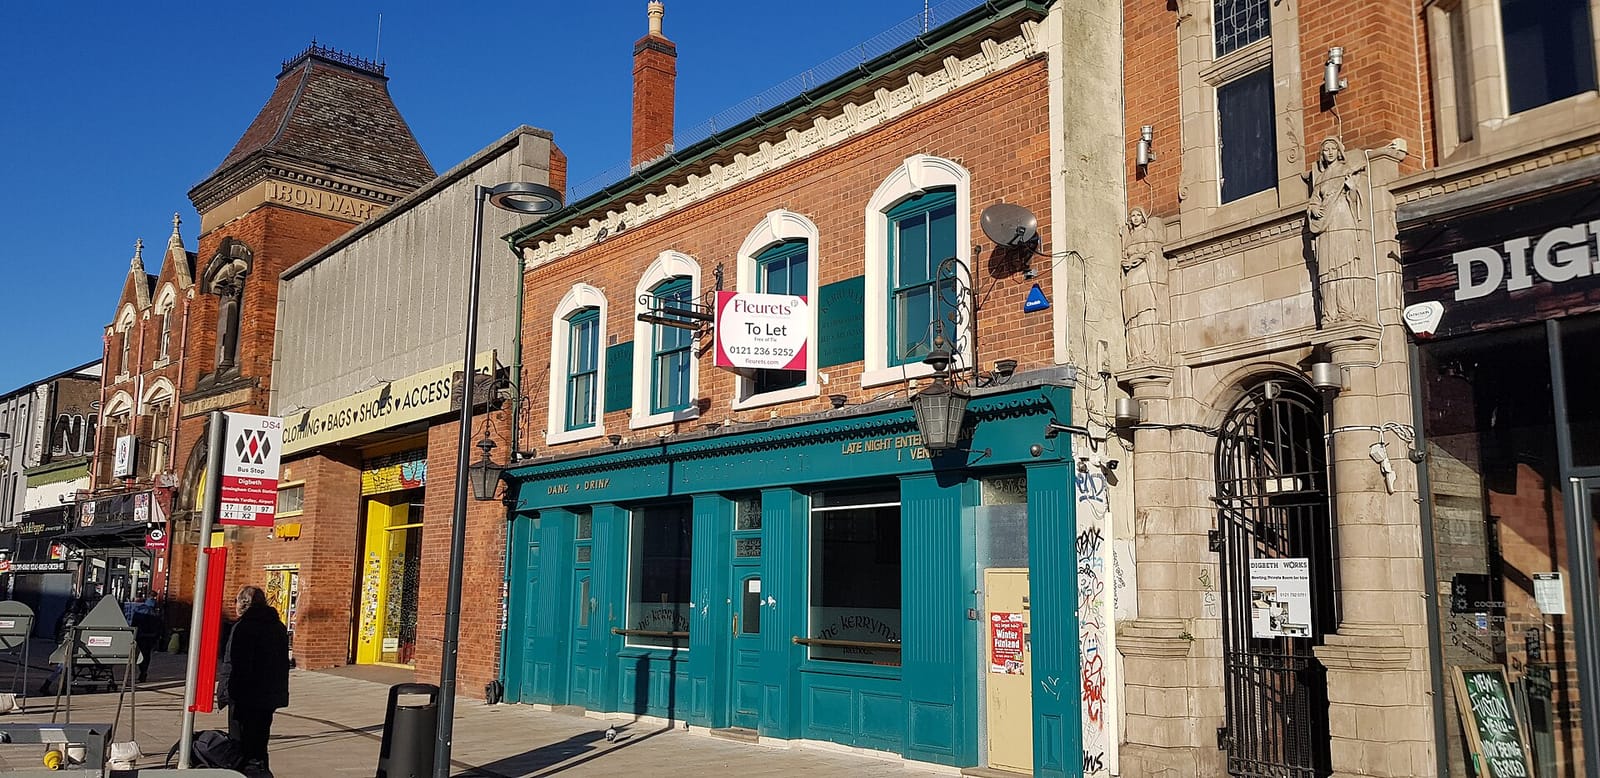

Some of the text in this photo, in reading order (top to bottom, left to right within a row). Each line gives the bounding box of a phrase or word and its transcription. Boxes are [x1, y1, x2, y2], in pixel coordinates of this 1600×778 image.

[269, 181, 322, 209] IRON
[1452, 219, 1600, 302] DIG
[734, 299, 792, 316] Fleurets
[744, 322, 787, 337] To Let
[729, 345, 794, 357] 0121 236 5252
[261, 420, 281, 430] DS4
[327, 407, 352, 432] BAGS
[842, 441, 863, 455] LATE
[864, 437, 893, 453] NIGHT
[250, 467, 265, 475] Stop
[238, 478, 262, 486] Digbeth
[1283, 561, 1308, 569] WORKS
[996, 629, 1018, 639] Winter
[994, 639, 1020, 649] Funland
